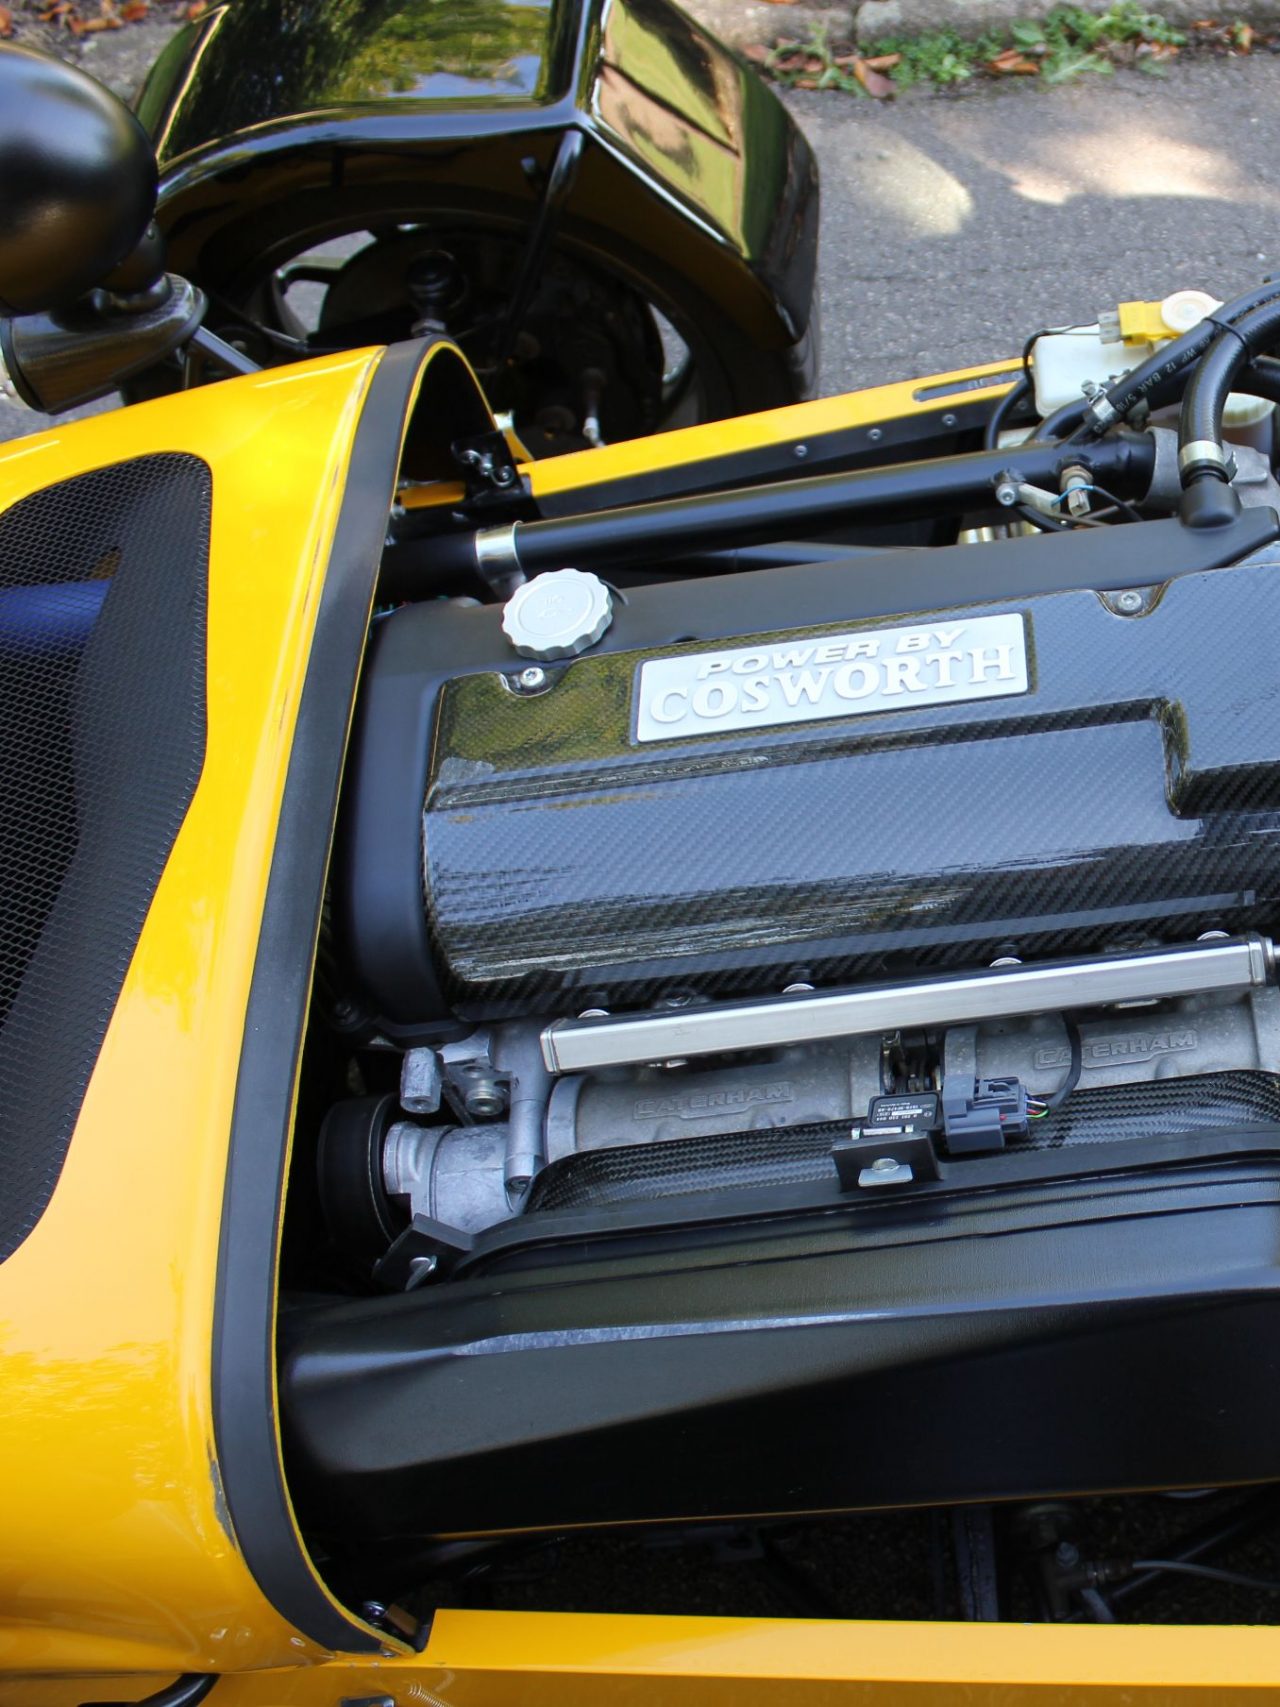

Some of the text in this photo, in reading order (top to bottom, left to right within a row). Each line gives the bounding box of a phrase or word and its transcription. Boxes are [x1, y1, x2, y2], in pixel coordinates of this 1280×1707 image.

[1138, 372, 1161, 393] BAR
[697, 627, 967, 680] POWER BY
[650, 643, 1016, 723] COSWORTH
[635, 1083, 790, 1115] CATERHAM
